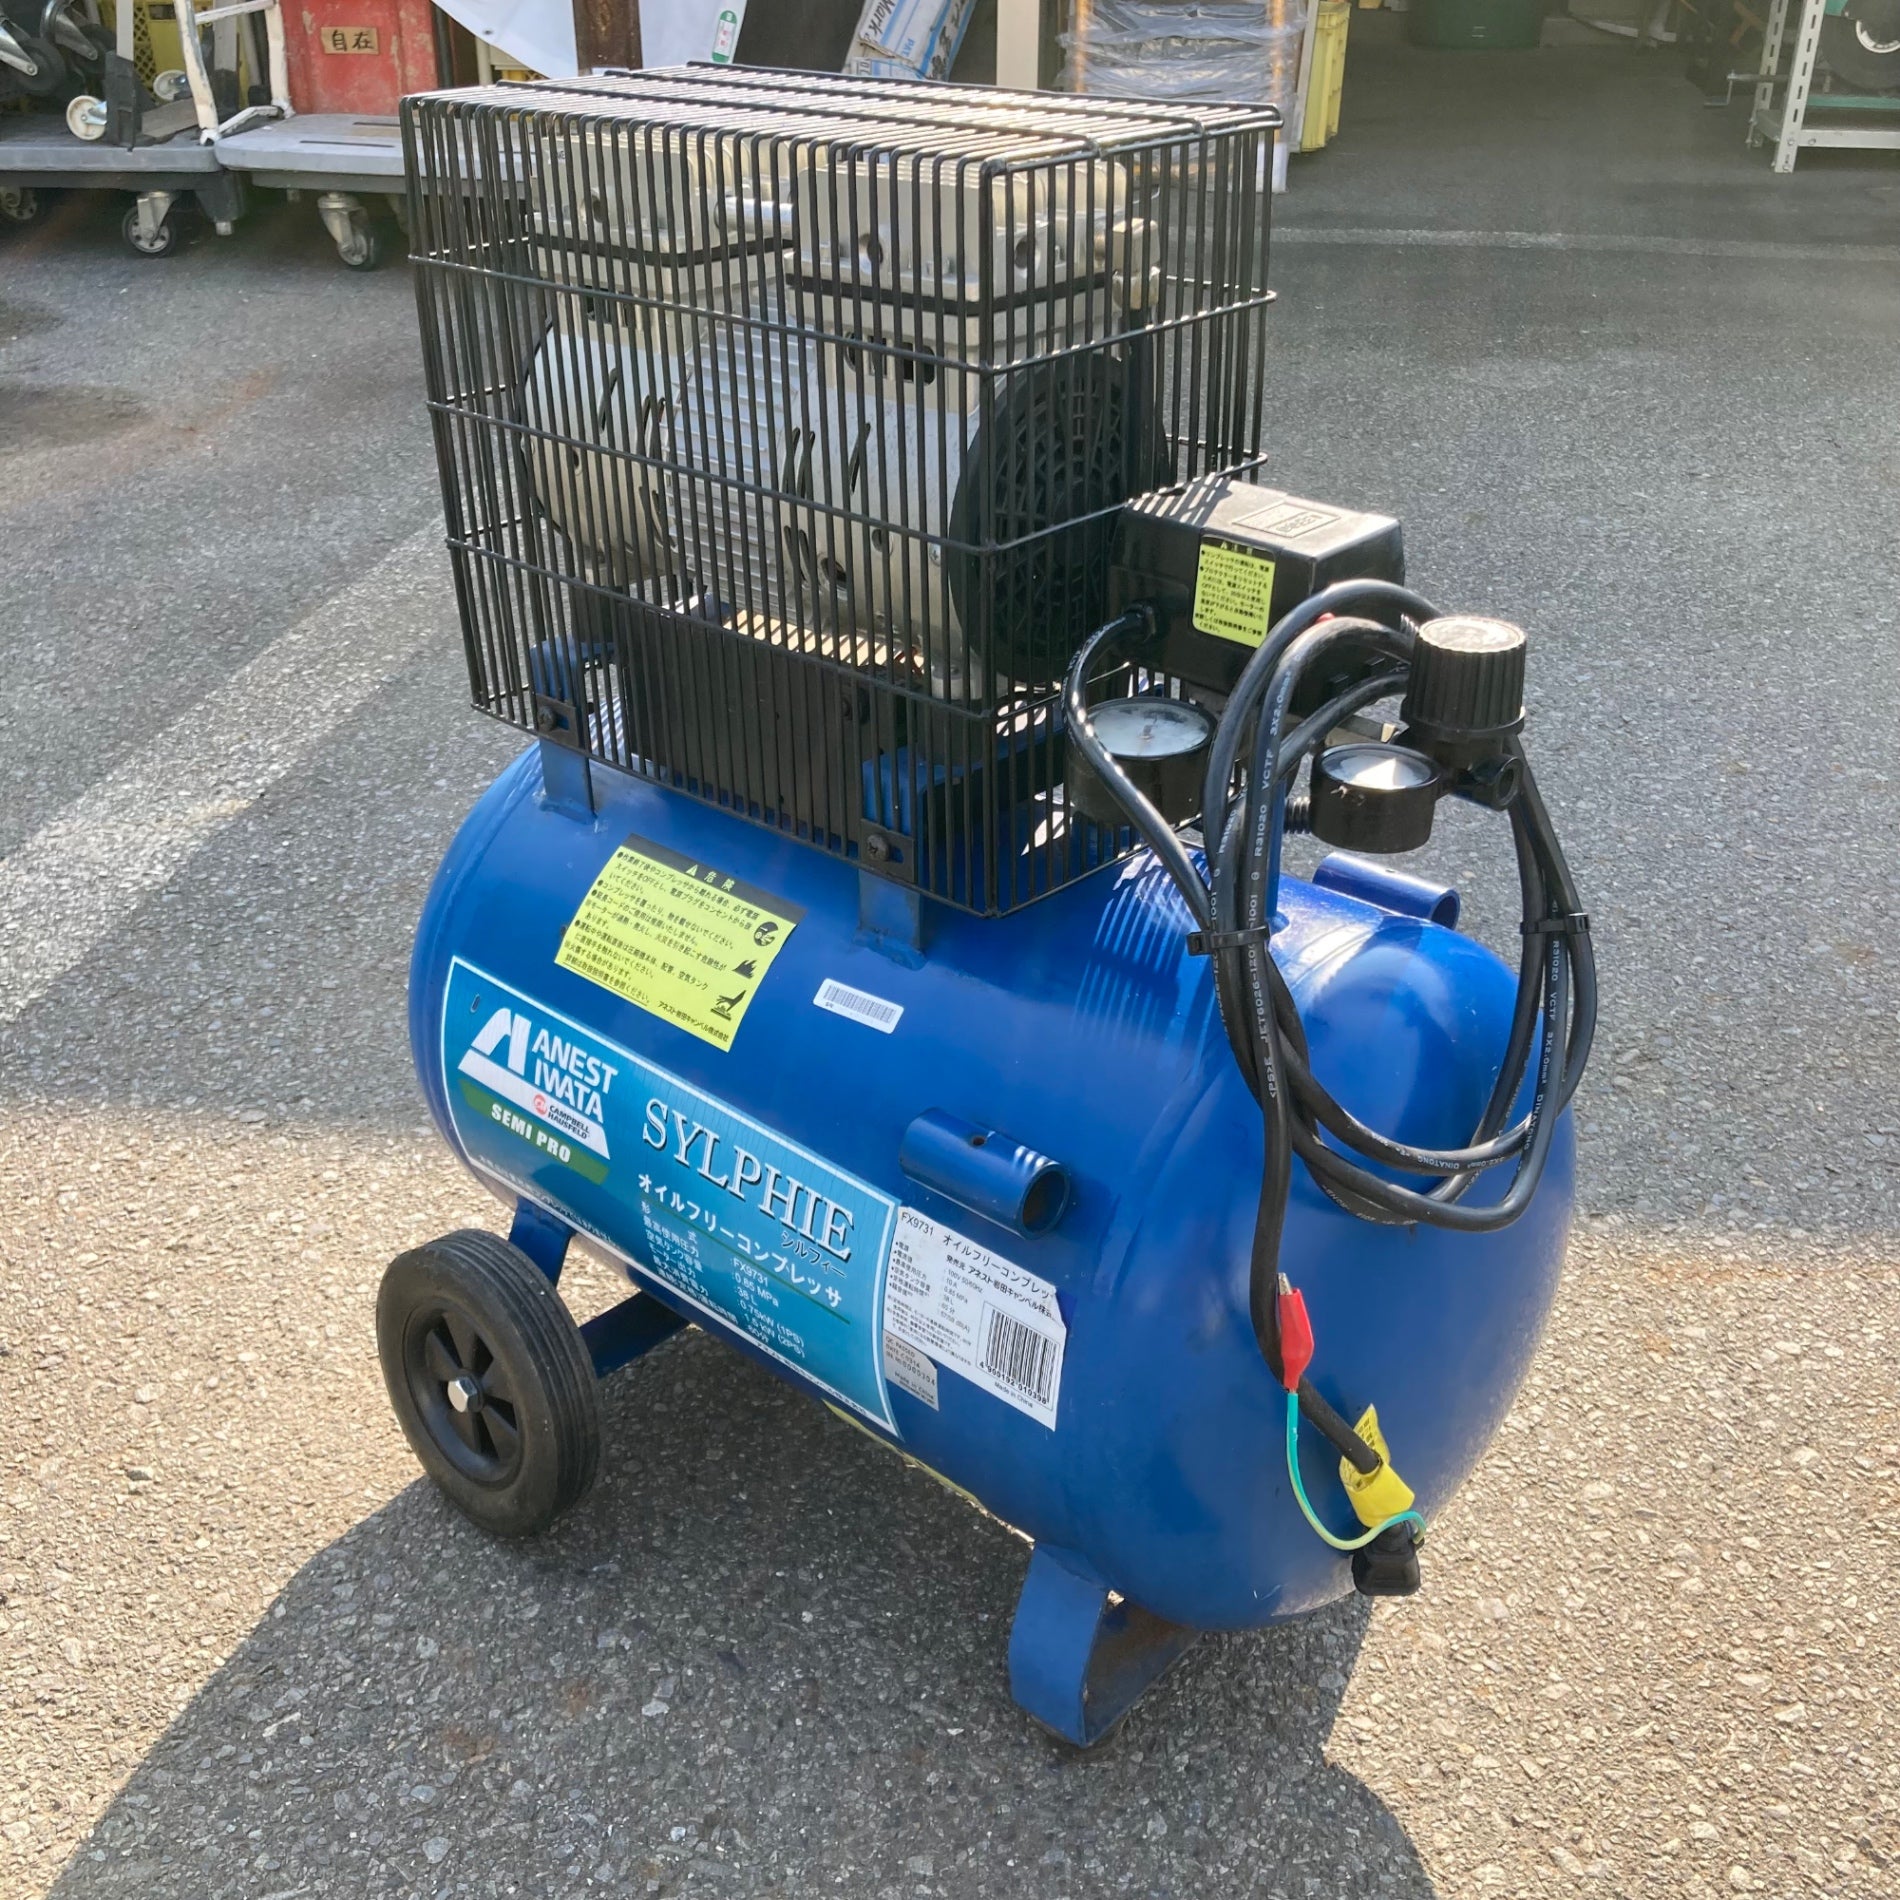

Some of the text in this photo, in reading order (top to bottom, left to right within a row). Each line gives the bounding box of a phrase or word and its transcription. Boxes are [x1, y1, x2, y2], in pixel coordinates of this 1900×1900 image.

[331, 29, 374, 52] 自在
[1261, 748, 1276, 790] VCTF
[532, 1028, 619, 1094] ANEST
[534, 1060, 605, 1124] IWATA
[490, 1103, 571, 1164] SEMI PRO
[548, 1112, 587, 1139] HAUSFELD
[549, 1105, 590, 1133] CAMPBELL
[642, 1098, 855, 1264] SYLPHIE
[638, 1172, 843, 1309] オイルフリーコンプレッサ
[900, 1209, 934, 1237] FX9731
[781, 1231, 847, 1280] シルフィー
[756, 1285, 780, 1308] MPa
[978, 1360, 984, 1369] 4
[1016, 1381, 1047, 1406] 010398
